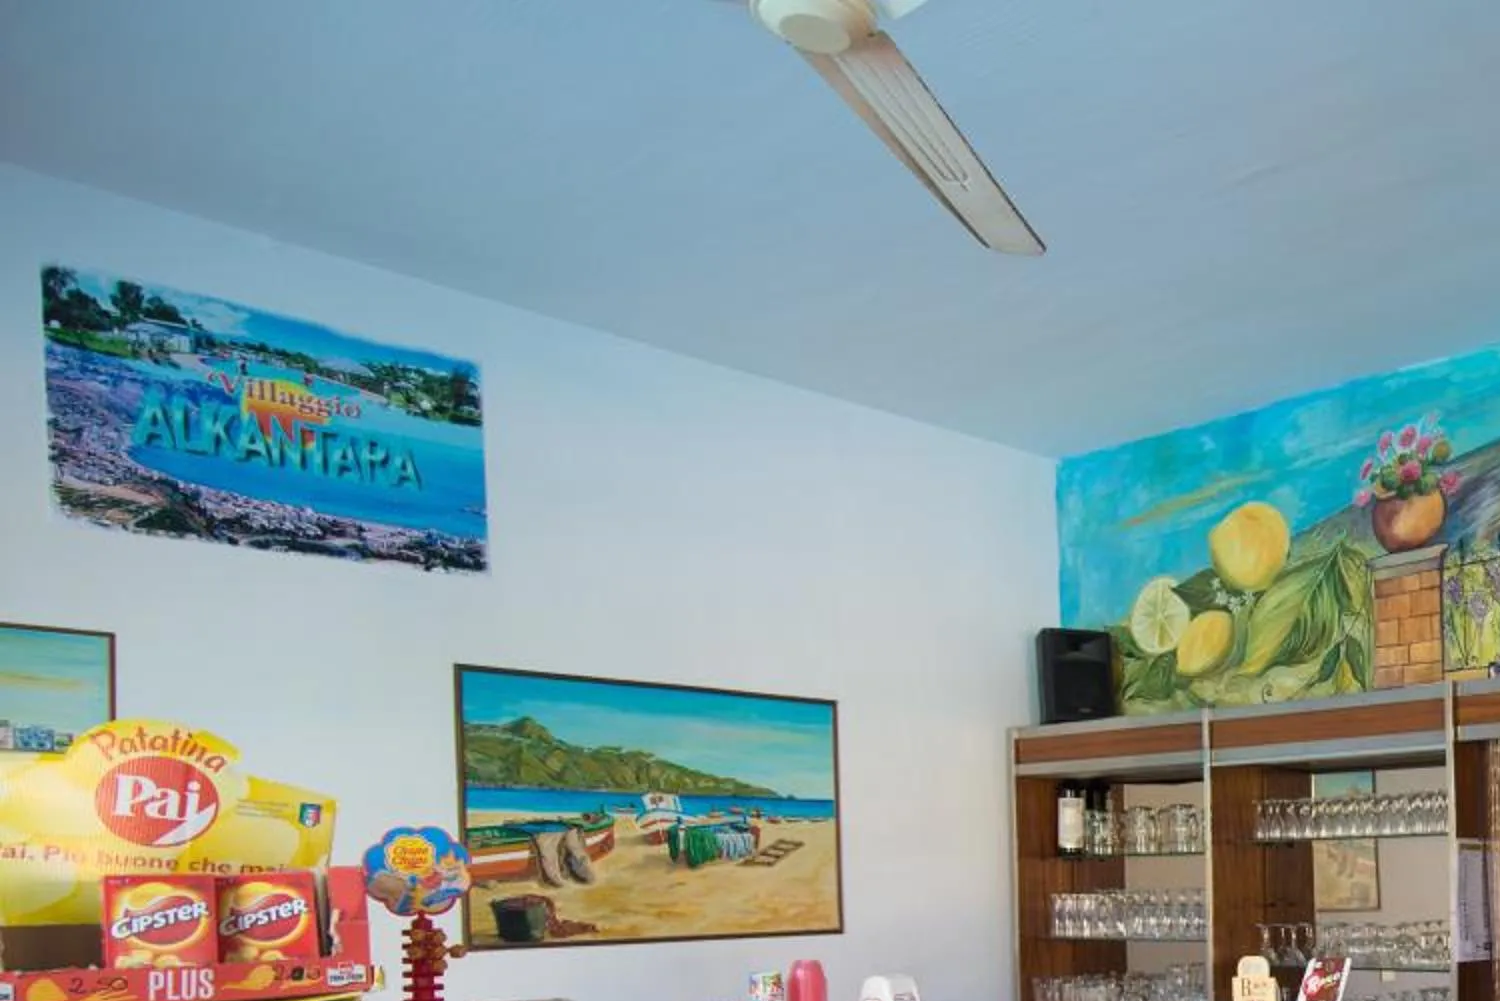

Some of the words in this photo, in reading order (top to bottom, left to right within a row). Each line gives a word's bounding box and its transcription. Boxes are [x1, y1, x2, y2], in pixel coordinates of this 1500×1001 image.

[207, 370, 361, 419] Villaggio
[132, 393, 421, 489] ALKANTARA
[91, 726, 229, 774] Patatina
[113, 774, 210, 832] Pai
[101, 848, 179, 872] buone
[188, 857, 234, 874] che
[111, 901, 210, 939] CIPSTER
[219, 898, 309, 937] CIPSTER
